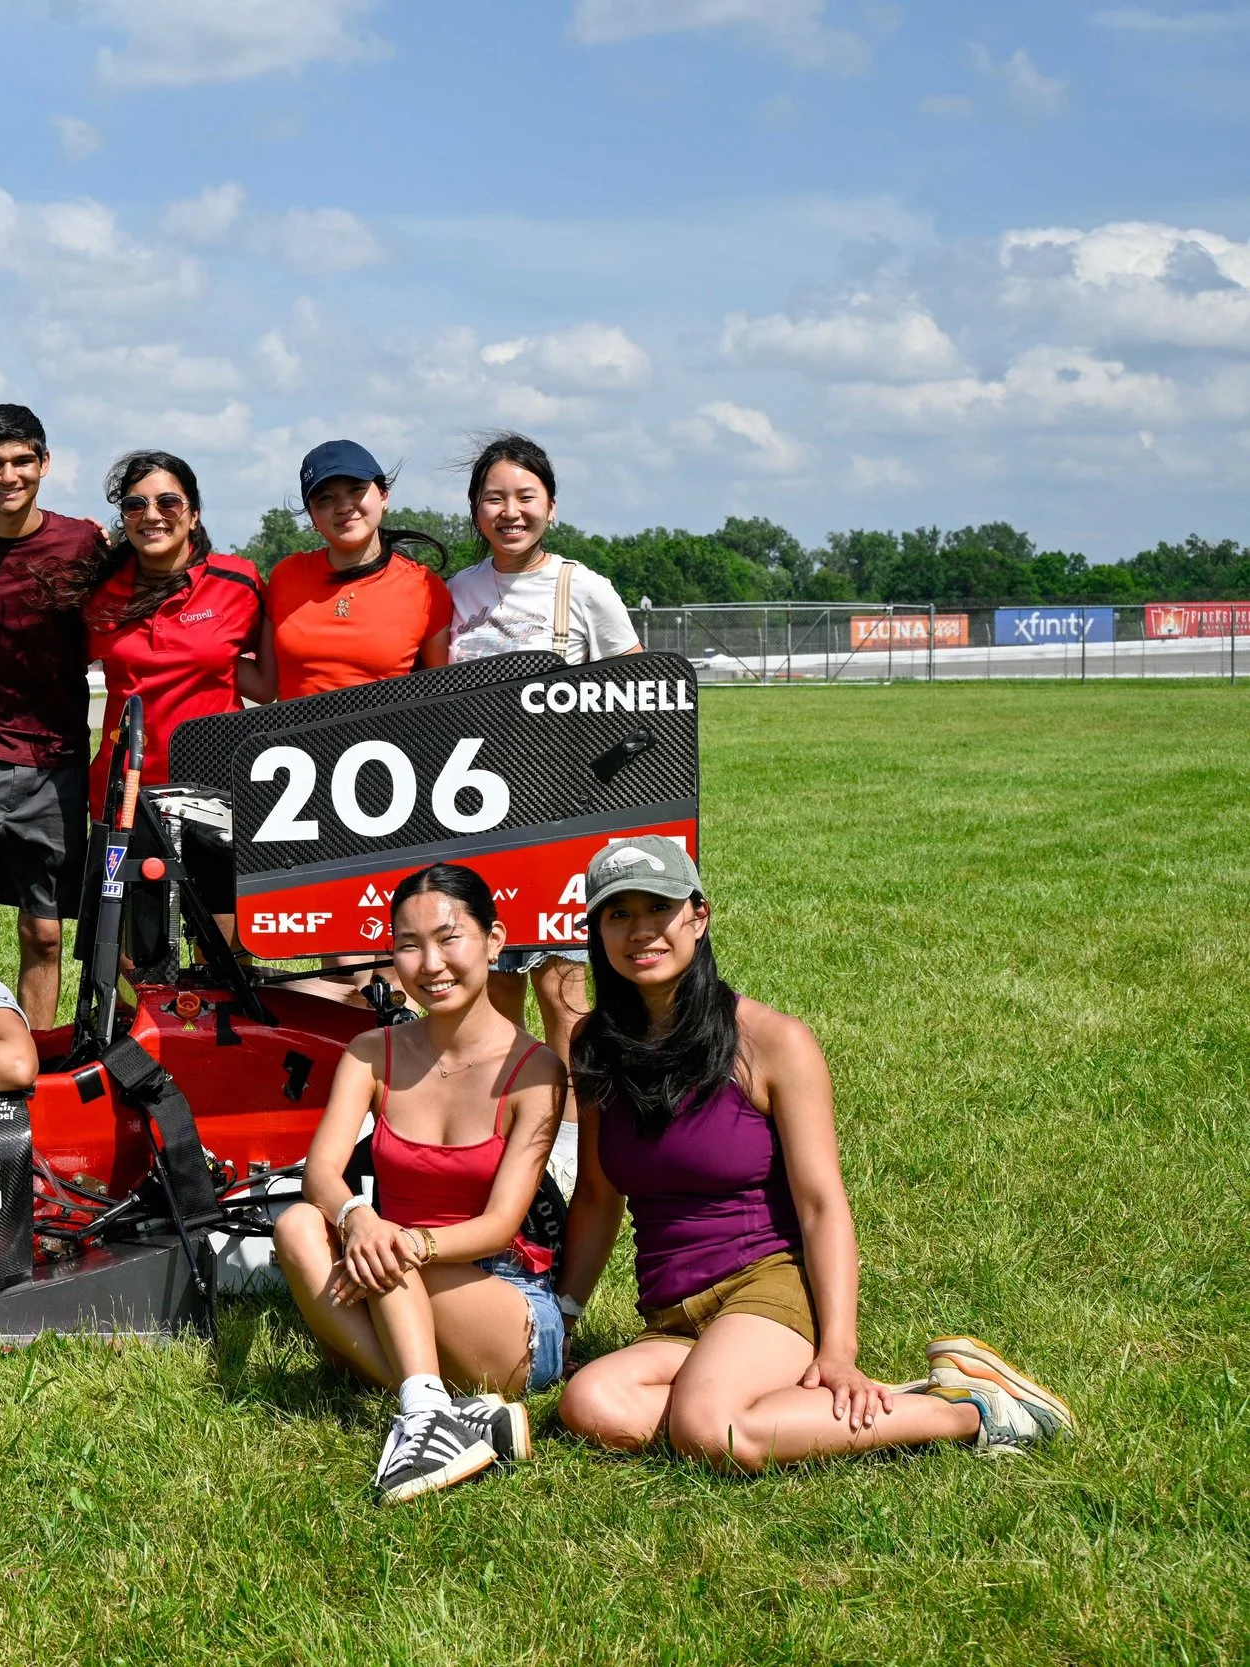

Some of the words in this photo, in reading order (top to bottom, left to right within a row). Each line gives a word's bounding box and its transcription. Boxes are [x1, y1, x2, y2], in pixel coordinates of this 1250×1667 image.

[179, 608, 213, 623] Cornell
[1014, 611, 1094, 642] xfinity
[521, 680, 694, 714] CORNELL
[250, 738, 510, 843] 206
[103, 885, 119, 893] OFF
[251, 912, 332, 933] SKF
